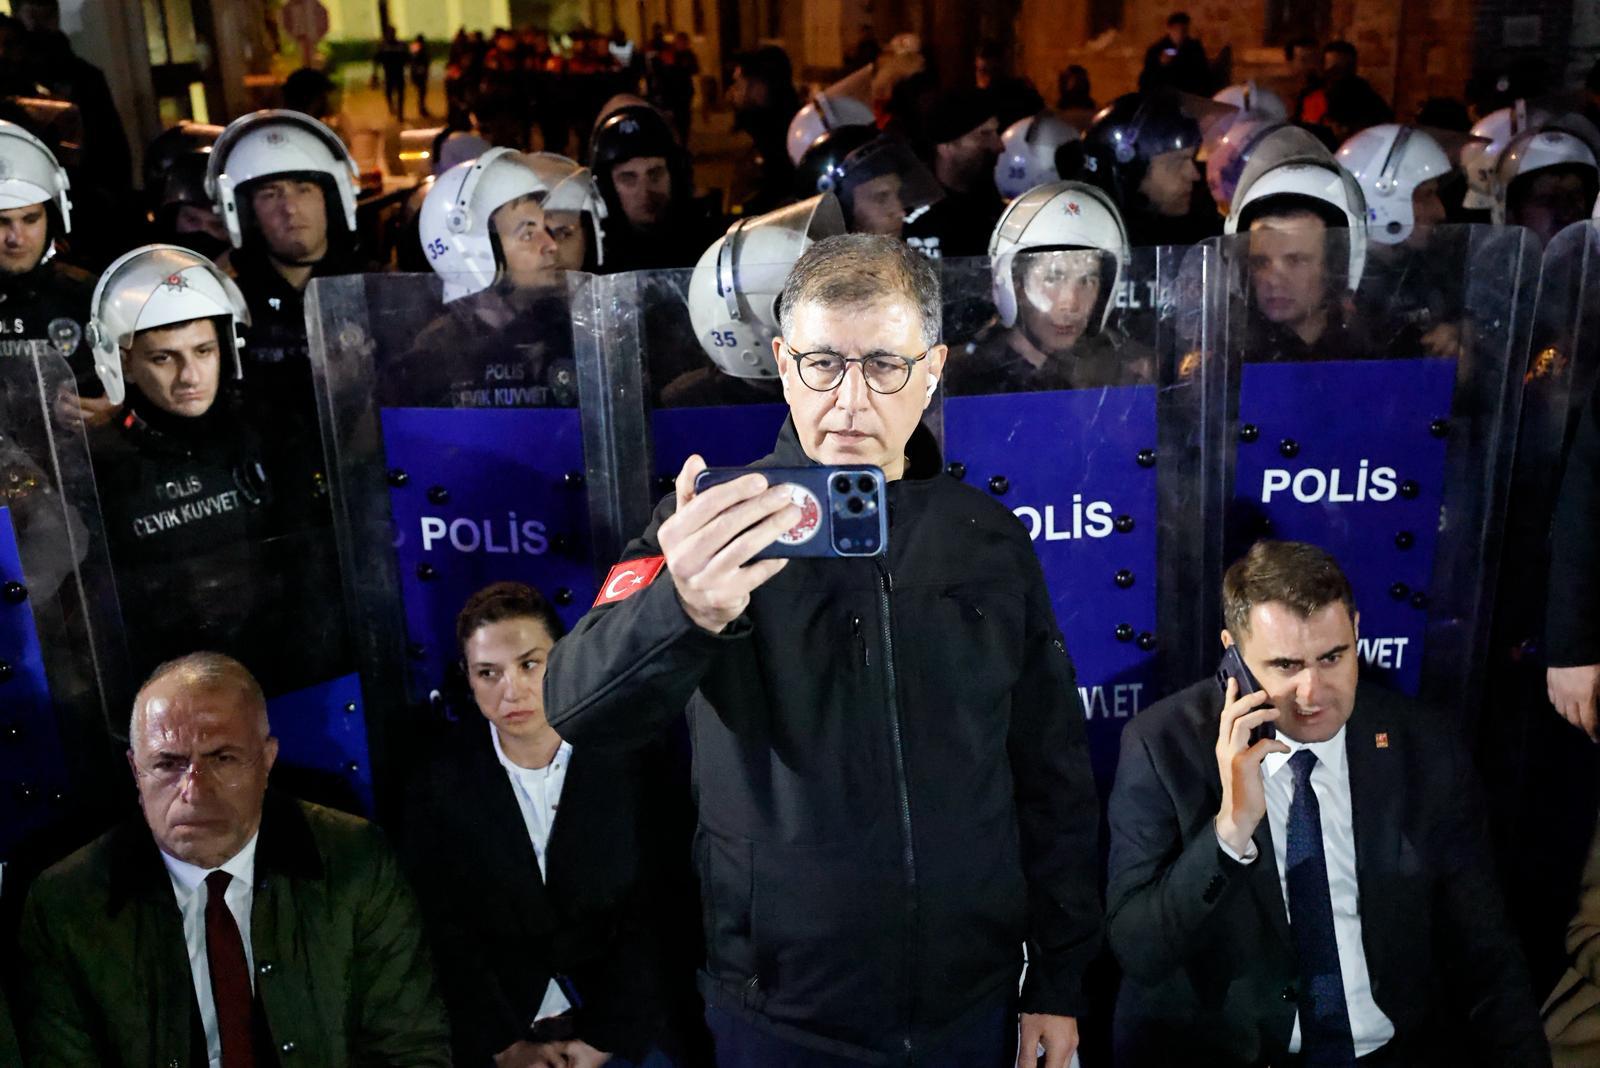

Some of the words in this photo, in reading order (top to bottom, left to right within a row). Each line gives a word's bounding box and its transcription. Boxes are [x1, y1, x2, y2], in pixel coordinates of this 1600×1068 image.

[711, 330, 738, 348] 35
[1261, 458, 1398, 504] POLİS
[180, 489, 240, 523] KUVVET
[1012, 493, 1114, 541] OLİS
[420, 510, 549, 556] POLİS
[1356, 636, 1409, 669] VET
